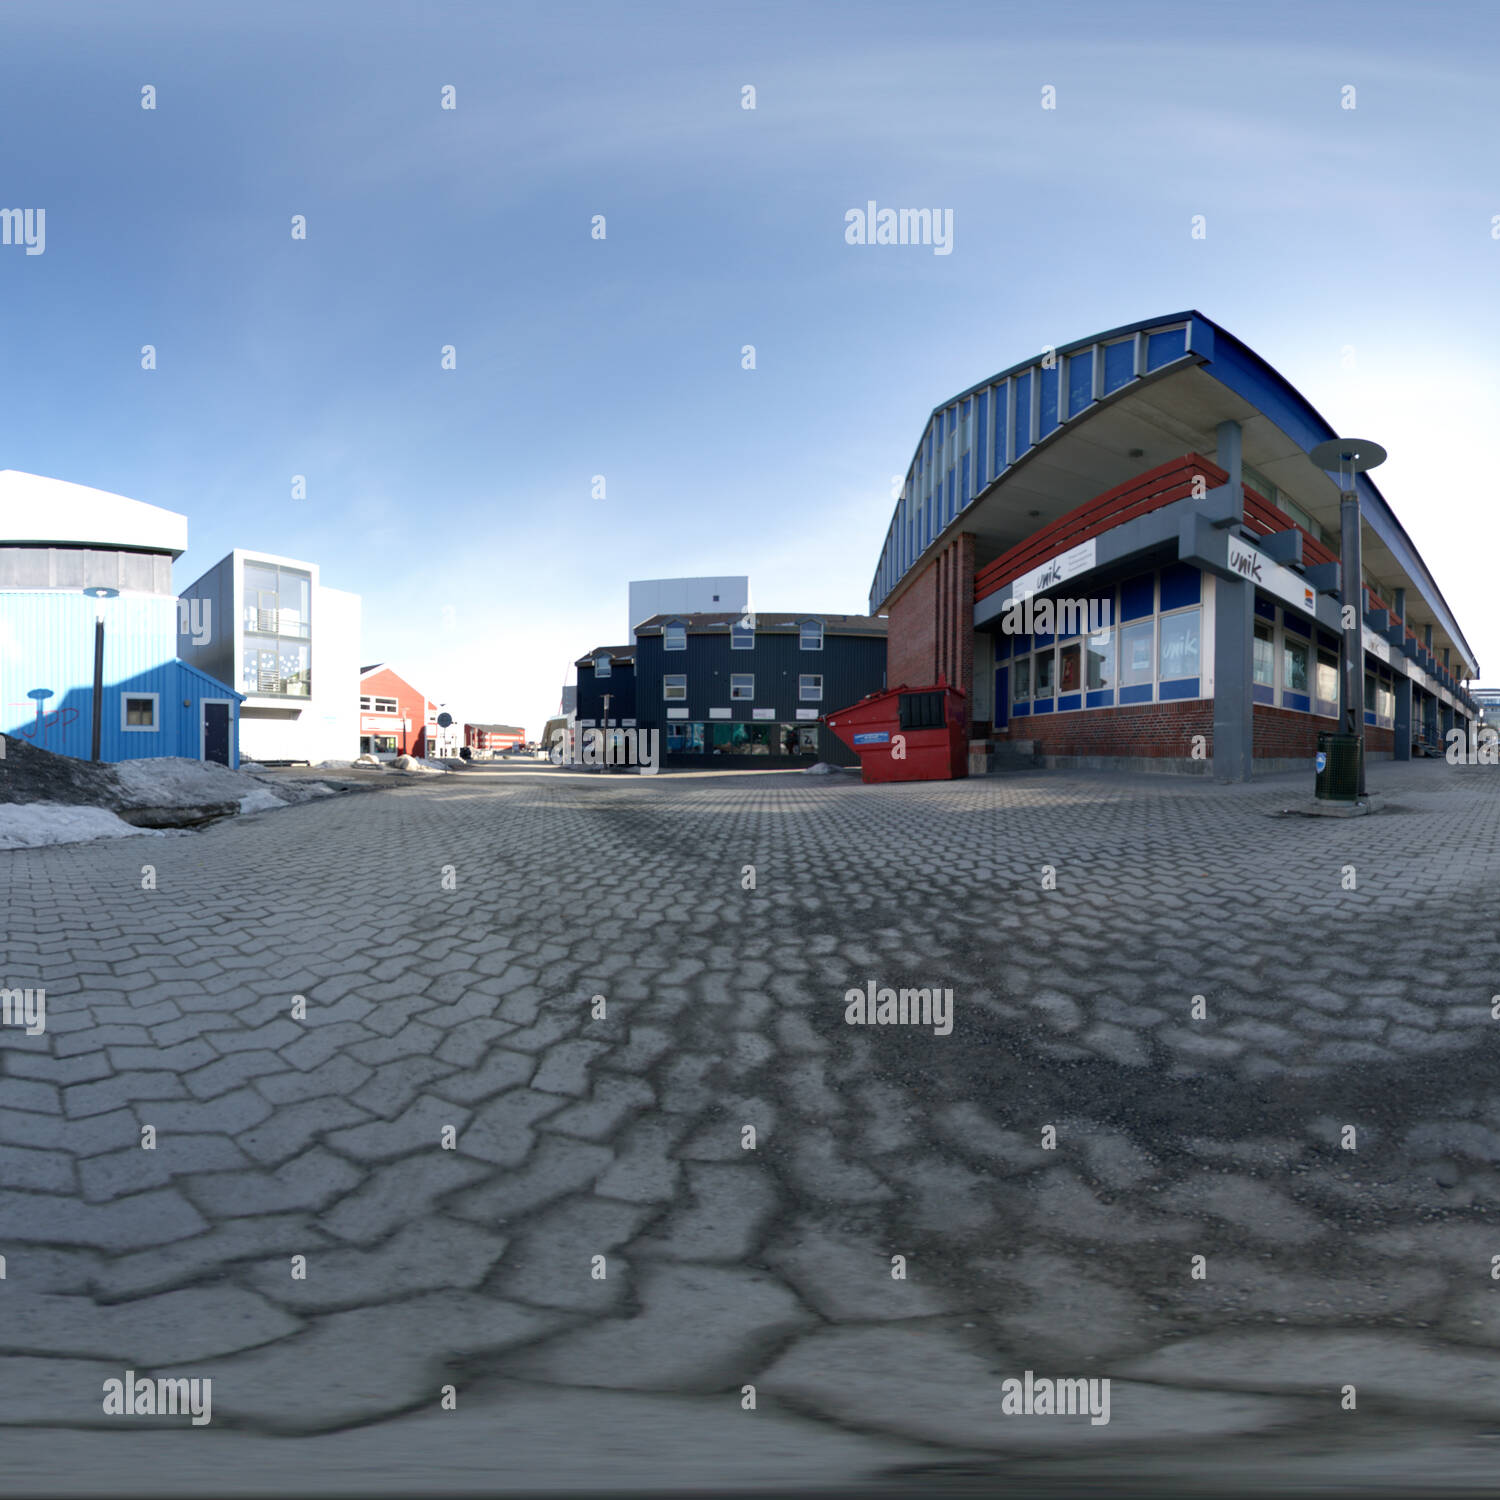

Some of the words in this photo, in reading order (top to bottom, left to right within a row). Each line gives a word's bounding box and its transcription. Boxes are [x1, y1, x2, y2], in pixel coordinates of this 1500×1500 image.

[1037, 559, 1062, 589] unik
[1230, 551, 1262, 583] unik
[1162, 629, 1197, 660] unik
